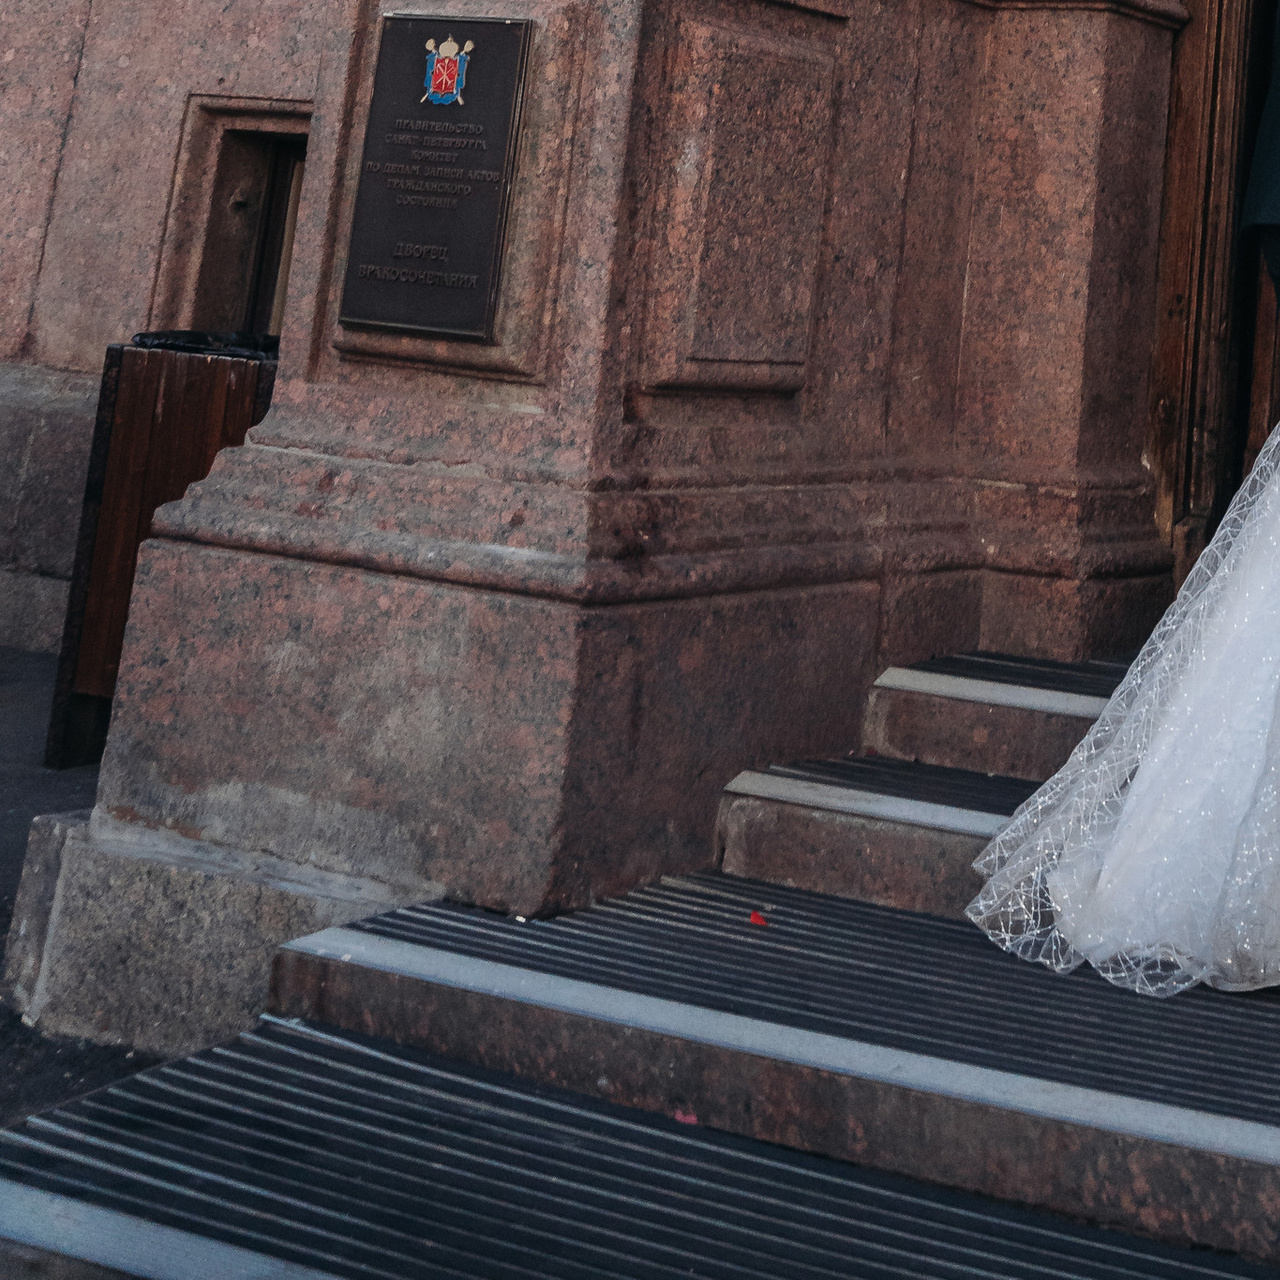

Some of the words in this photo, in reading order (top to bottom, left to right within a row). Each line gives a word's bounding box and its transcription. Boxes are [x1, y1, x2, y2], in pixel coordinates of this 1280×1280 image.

[395, 118, 483, 134] ПРАВИТЕЛЬСТВО
[384, 132, 487, 150] САНКТ-ПЕТЕРБУРГА
[411, 149, 459, 163] КОМИТЕТ
[365, 160, 380, 171] ПО
[382, 162, 421, 176] ДЕЛАМ
[424, 166, 464, 179] ЗАПИСИ
[467, 169, 501, 182] АКТОВ
[386, 177, 472, 196] ГРАЖДАНСКОГО
[392, 243, 449, 262] ДВОРЕЦ
[358, 264, 479, 288] БРАКОСОЧЕТАНИЯ
